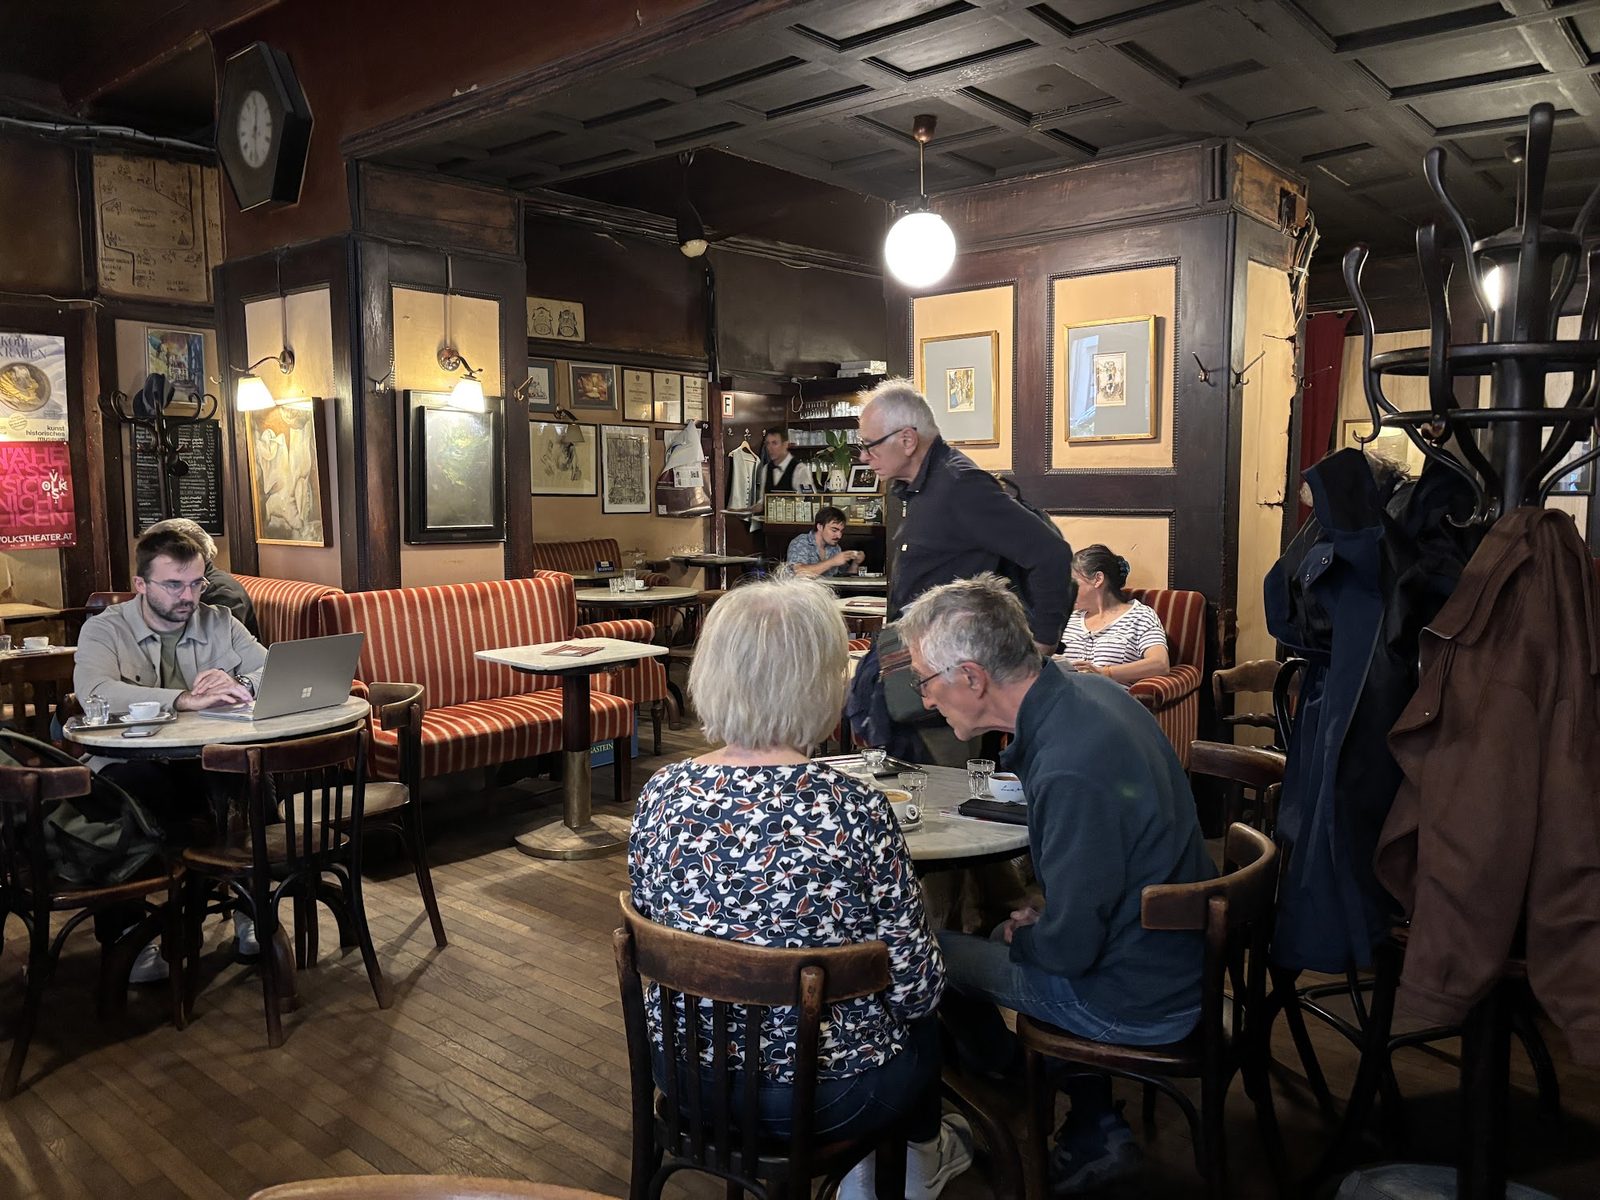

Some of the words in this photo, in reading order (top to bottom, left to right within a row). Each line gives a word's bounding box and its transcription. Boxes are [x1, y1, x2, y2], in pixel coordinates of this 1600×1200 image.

[0, 347, 46, 359] RAGEN
[725, 397, 731, 413] F
[0, 533, 72, 543] OLKSTHEATER.AT
